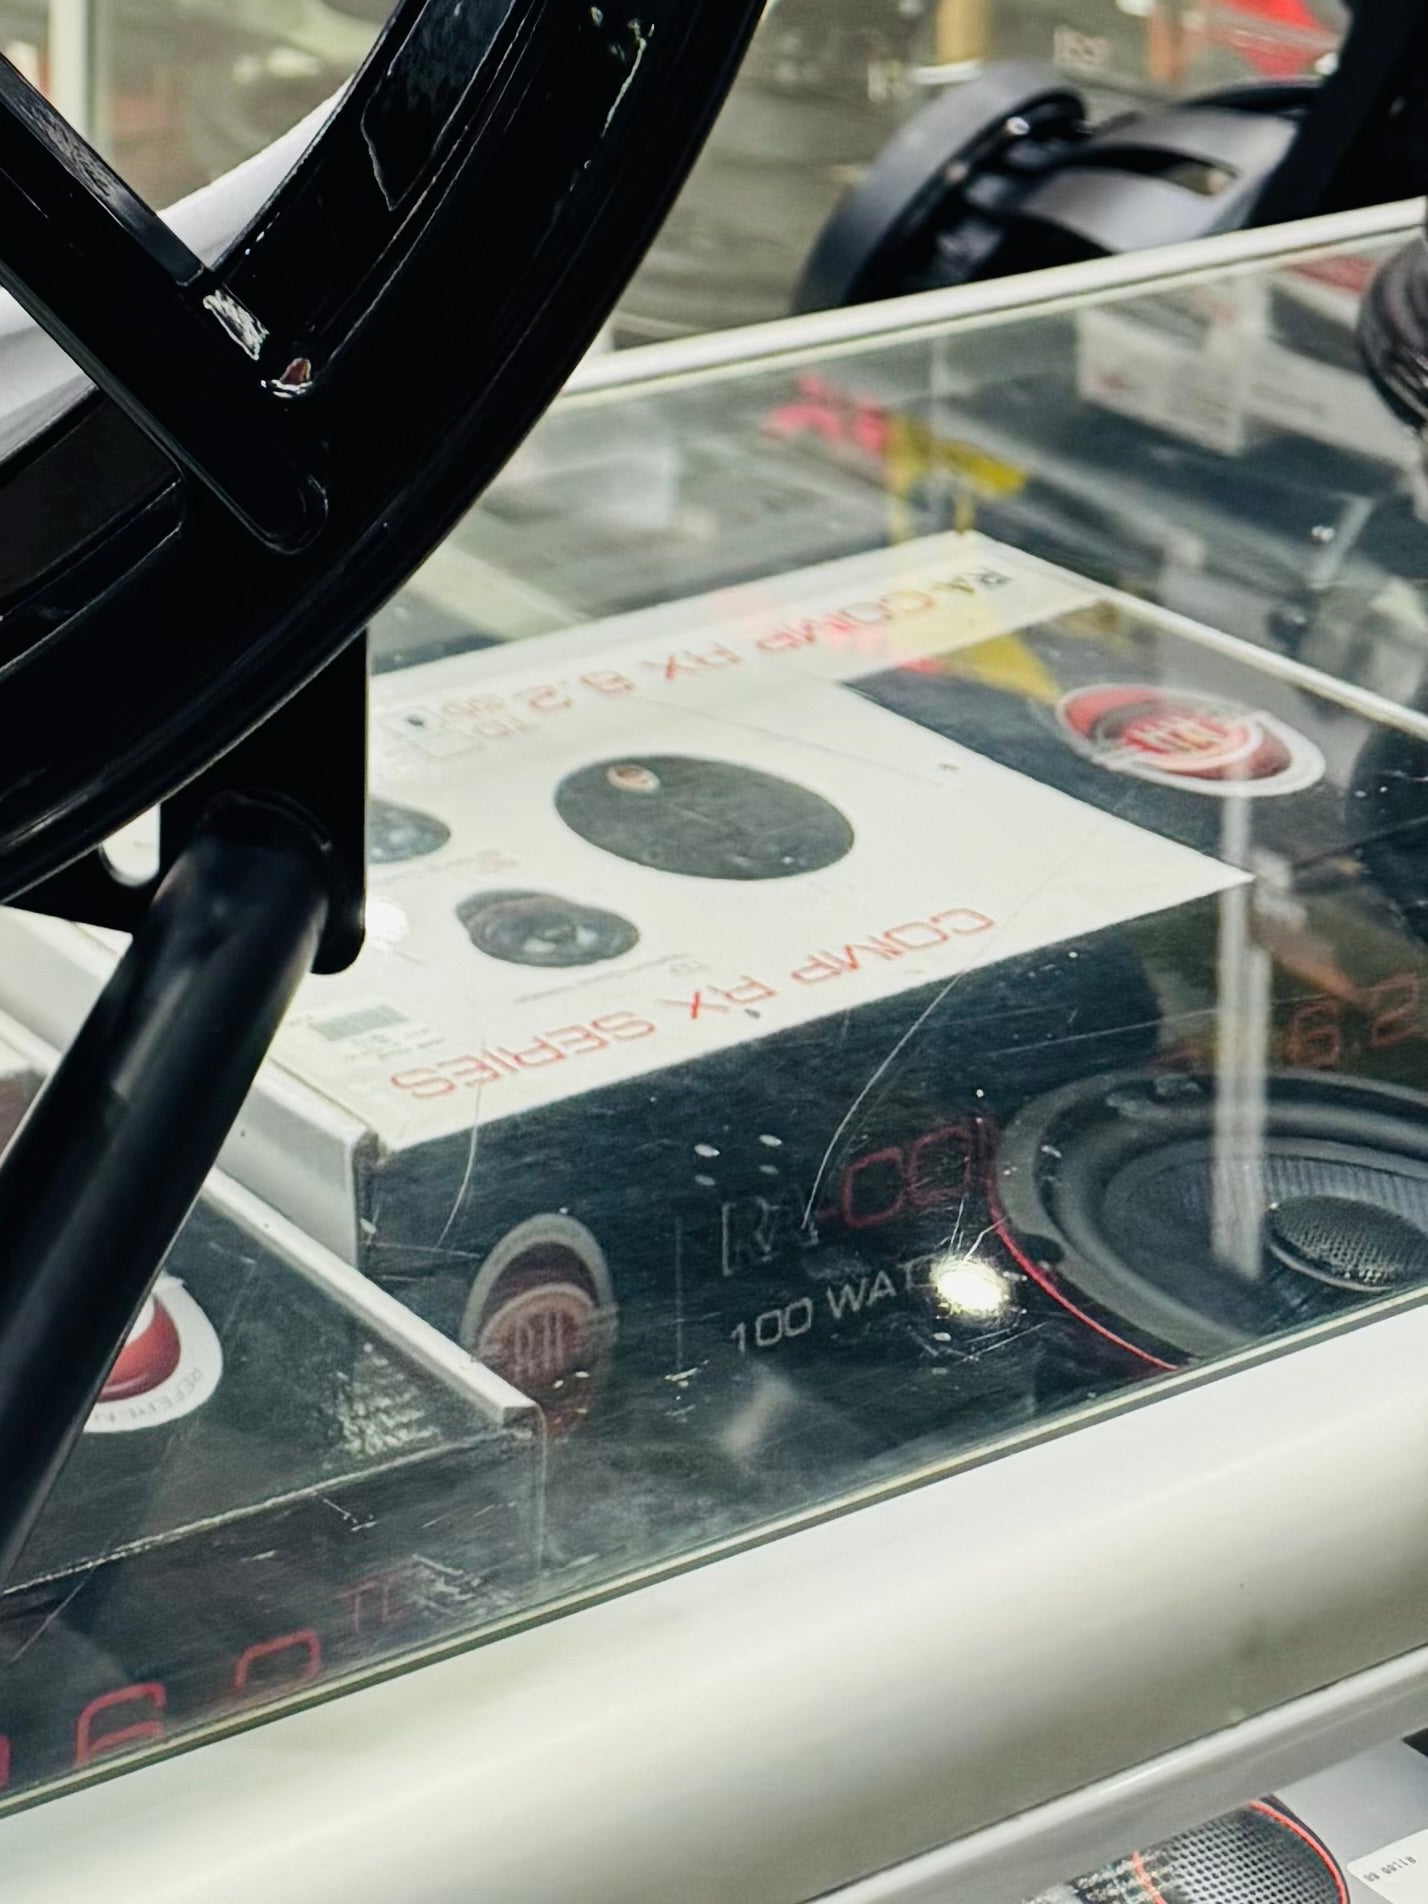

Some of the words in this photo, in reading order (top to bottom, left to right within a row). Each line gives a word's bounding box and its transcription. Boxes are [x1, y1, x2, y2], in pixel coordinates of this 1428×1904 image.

[787, 903, 996, 986] COMP
[387, 1009, 658, 1101] SERIES
[730, 1296, 814, 1354] 100
